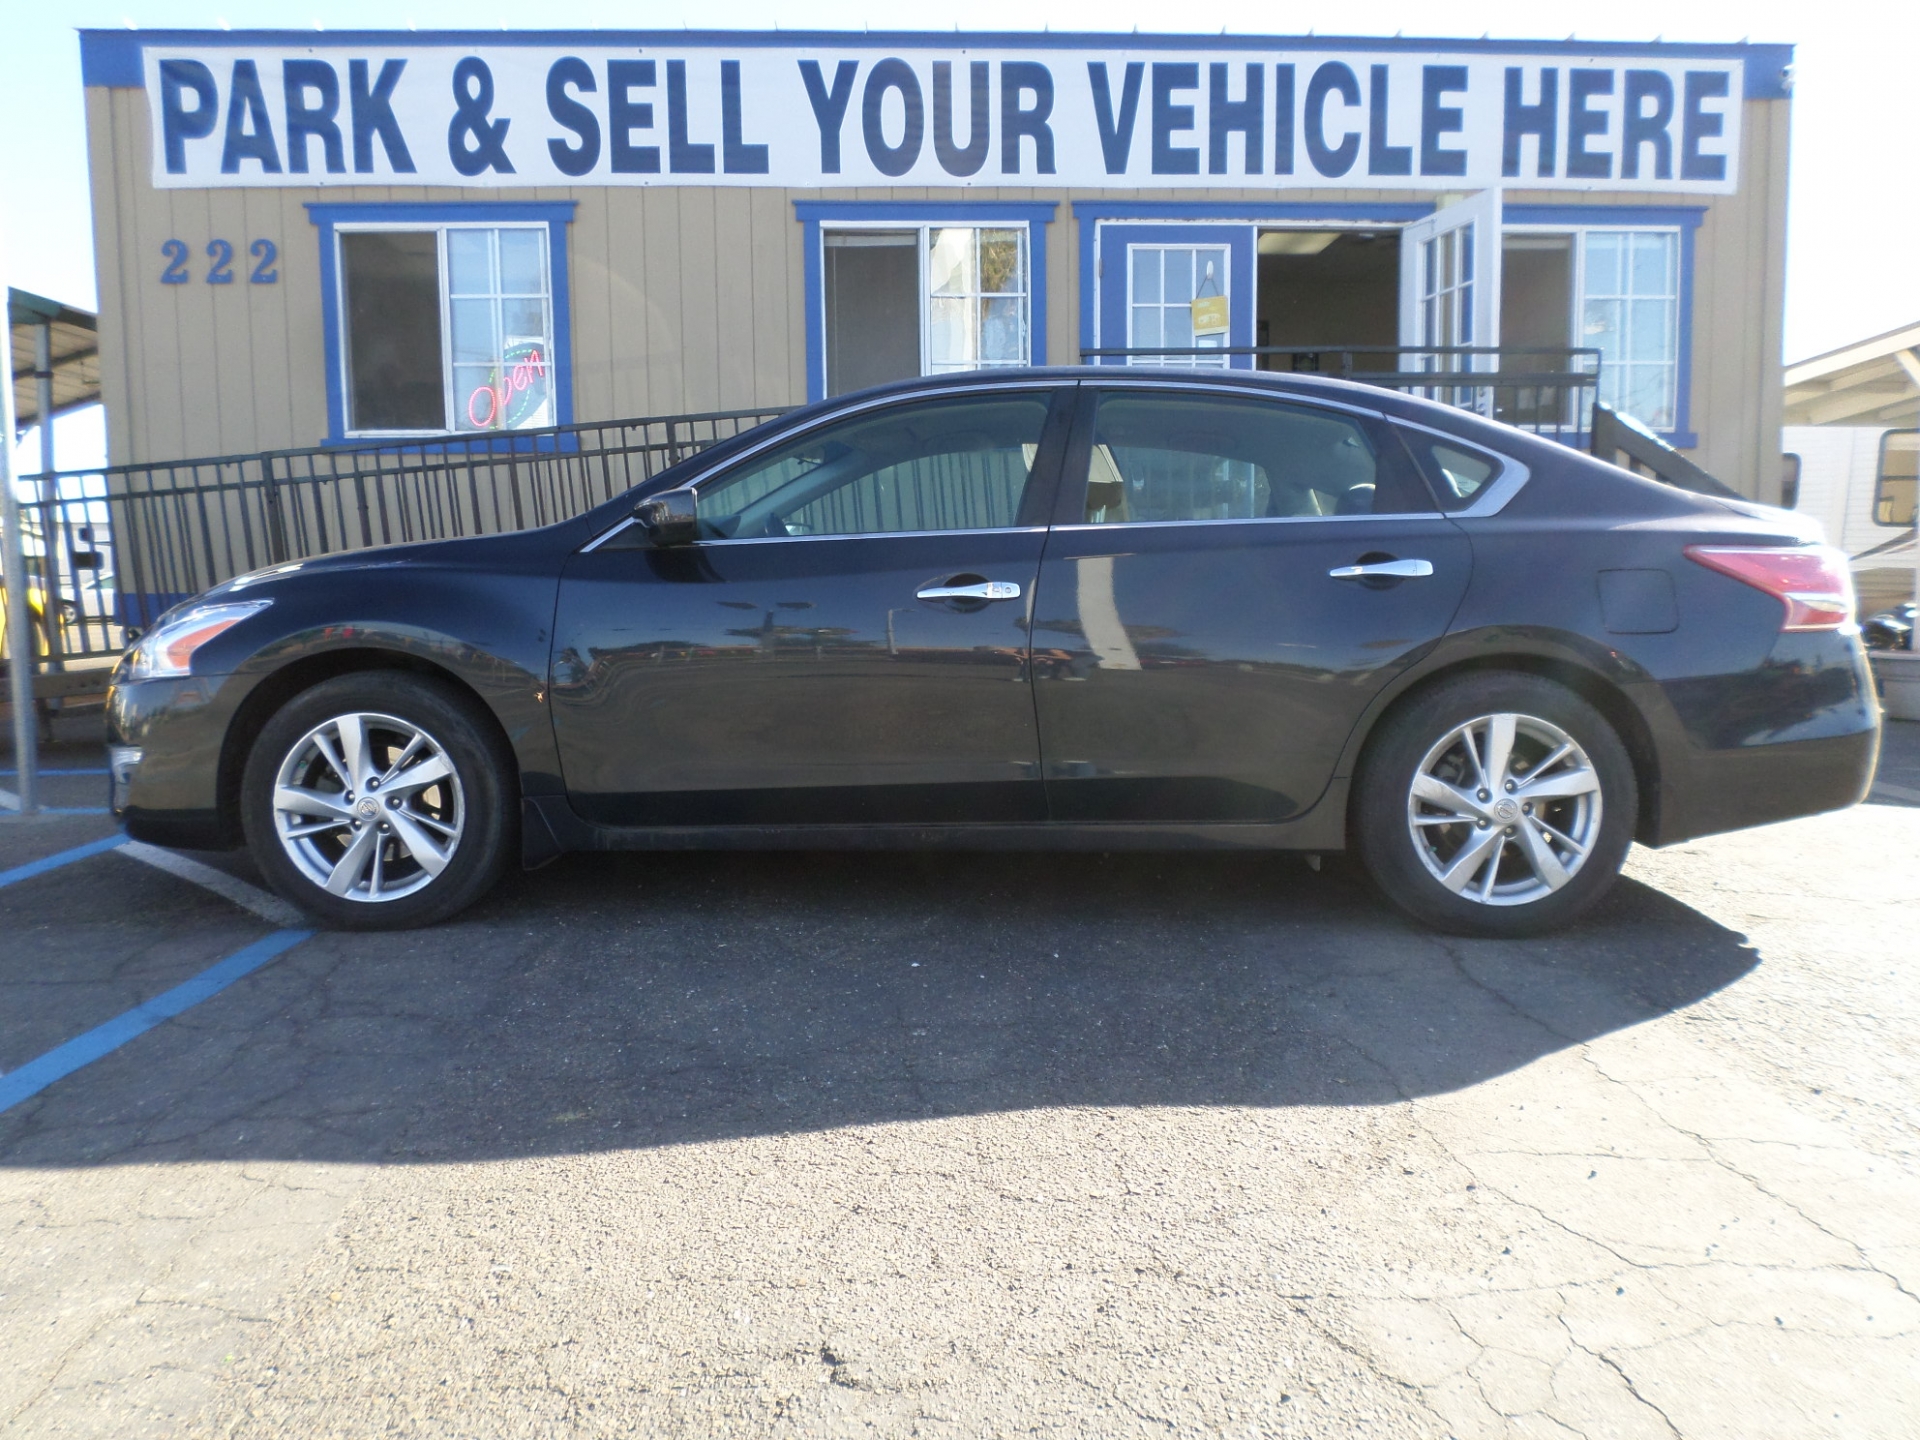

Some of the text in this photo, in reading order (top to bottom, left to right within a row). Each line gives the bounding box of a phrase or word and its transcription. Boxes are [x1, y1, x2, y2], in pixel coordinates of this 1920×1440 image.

[158, 55, 1730, 181] PARK & SELL YOUR VEHICLE HERE
[159, 238, 278, 286] 222
[468, 349, 545, 428] Open
